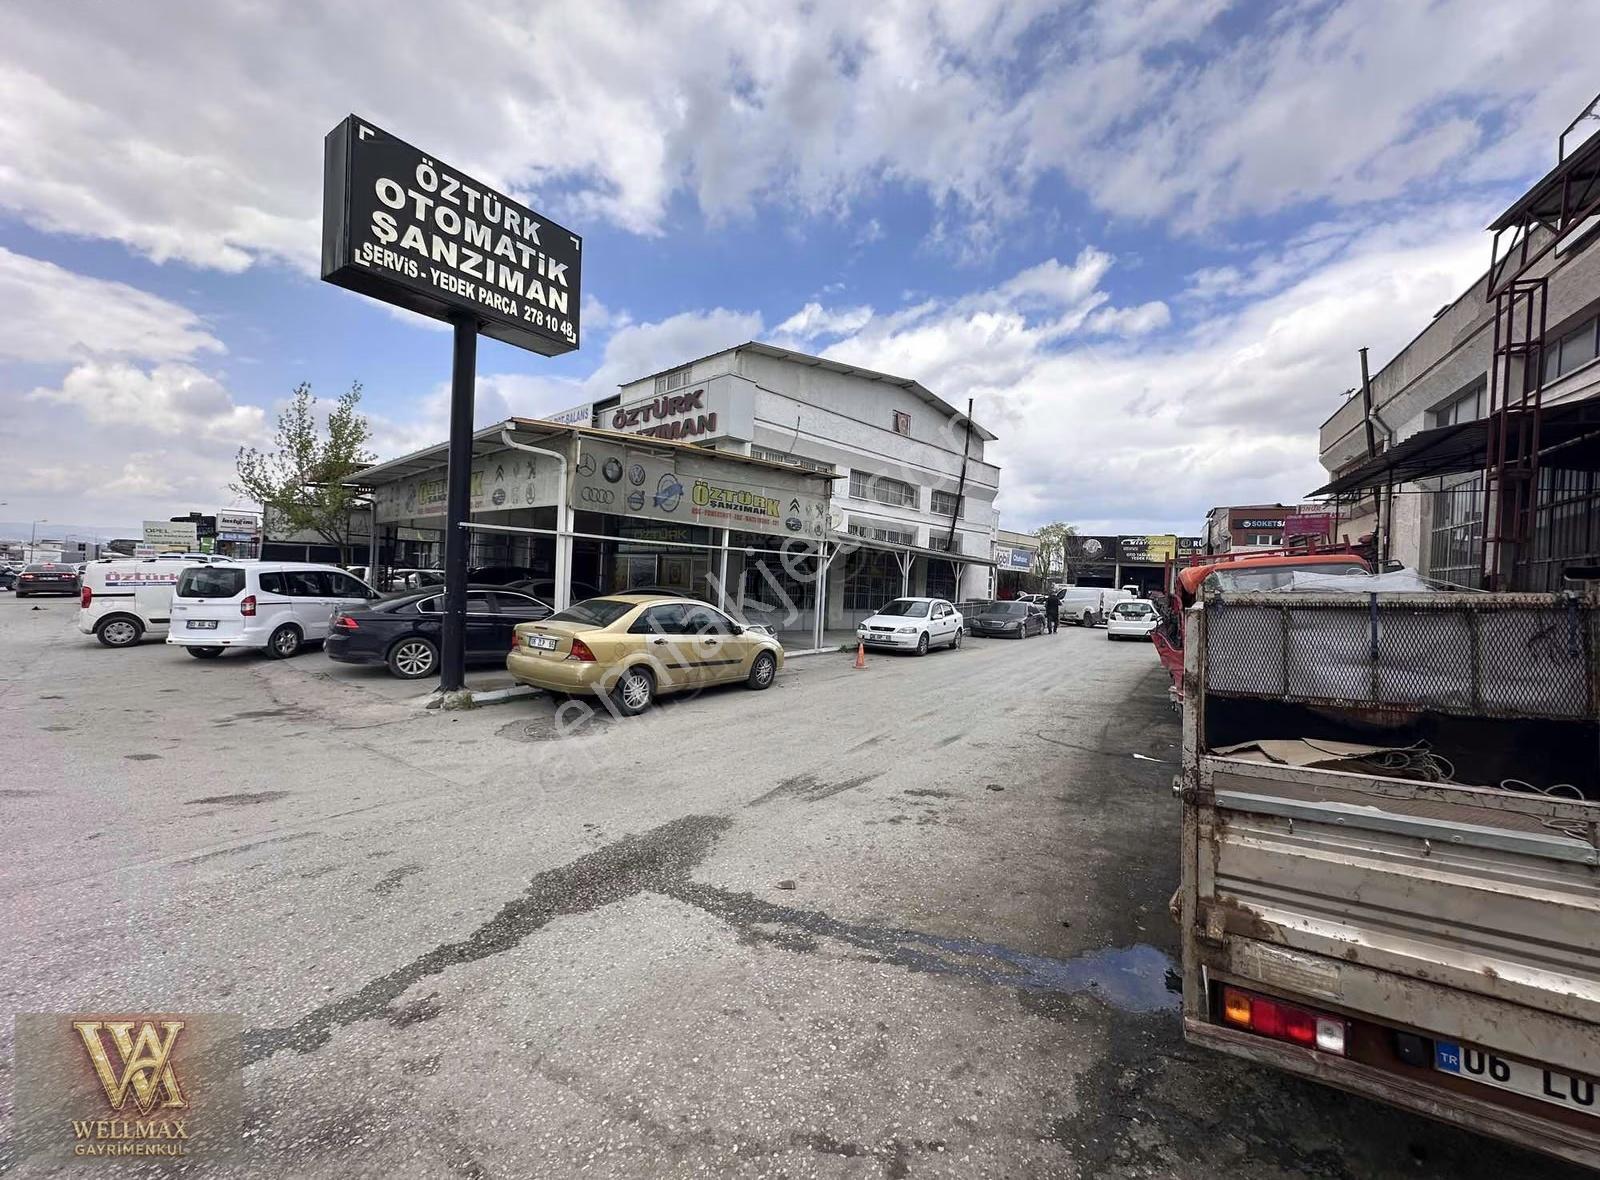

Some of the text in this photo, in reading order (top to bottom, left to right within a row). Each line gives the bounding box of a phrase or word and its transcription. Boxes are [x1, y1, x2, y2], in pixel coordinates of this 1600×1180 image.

[415, 157, 541, 246] ÖZTÜRK
[371, 210, 568, 315] ŞANZIMAN
[430, 267, 475, 300] YEDEK
[478, 290, 518, 317] PARÇA
[523, 305, 543, 326] 278
[546, 315, 558, 332] 10
[560, 320, 573, 337] 48
[612, 389, 704, 429] ÖZTÜRK
[692, 480, 780, 517] ÖZTÜRK
[710, 501, 766, 515] ŞANZIMAN
[1440, 1052, 1458, 1065] TR
